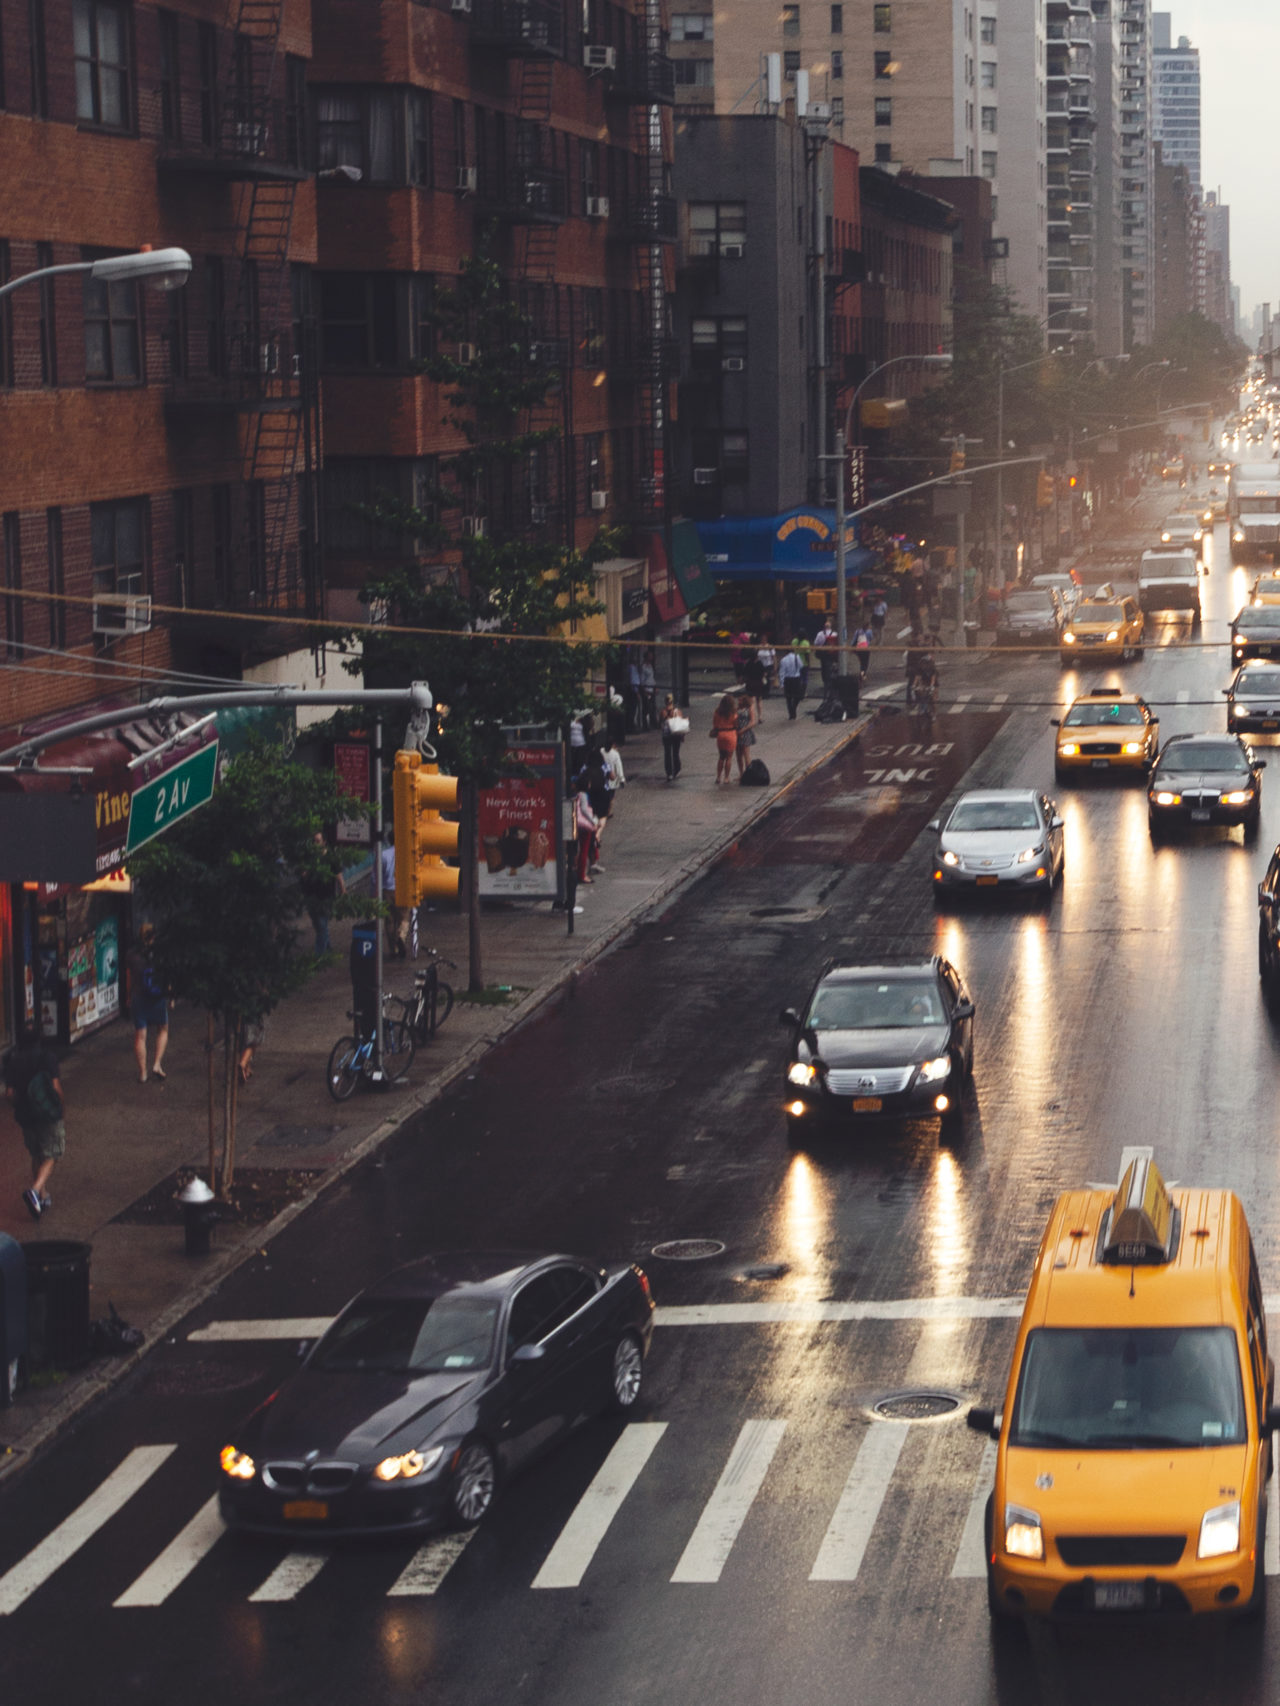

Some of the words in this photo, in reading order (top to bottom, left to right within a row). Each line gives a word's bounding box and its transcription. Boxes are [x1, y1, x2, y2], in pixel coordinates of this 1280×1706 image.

[865, 742, 955, 757] BUS
[154, 787, 166, 823] 2
[168, 777, 190, 814] Av
[486, 797, 510, 807] New
[513, 796, 546, 807] York's
[499, 808, 533, 820] Finest
[362, 941, 372, 956] P
